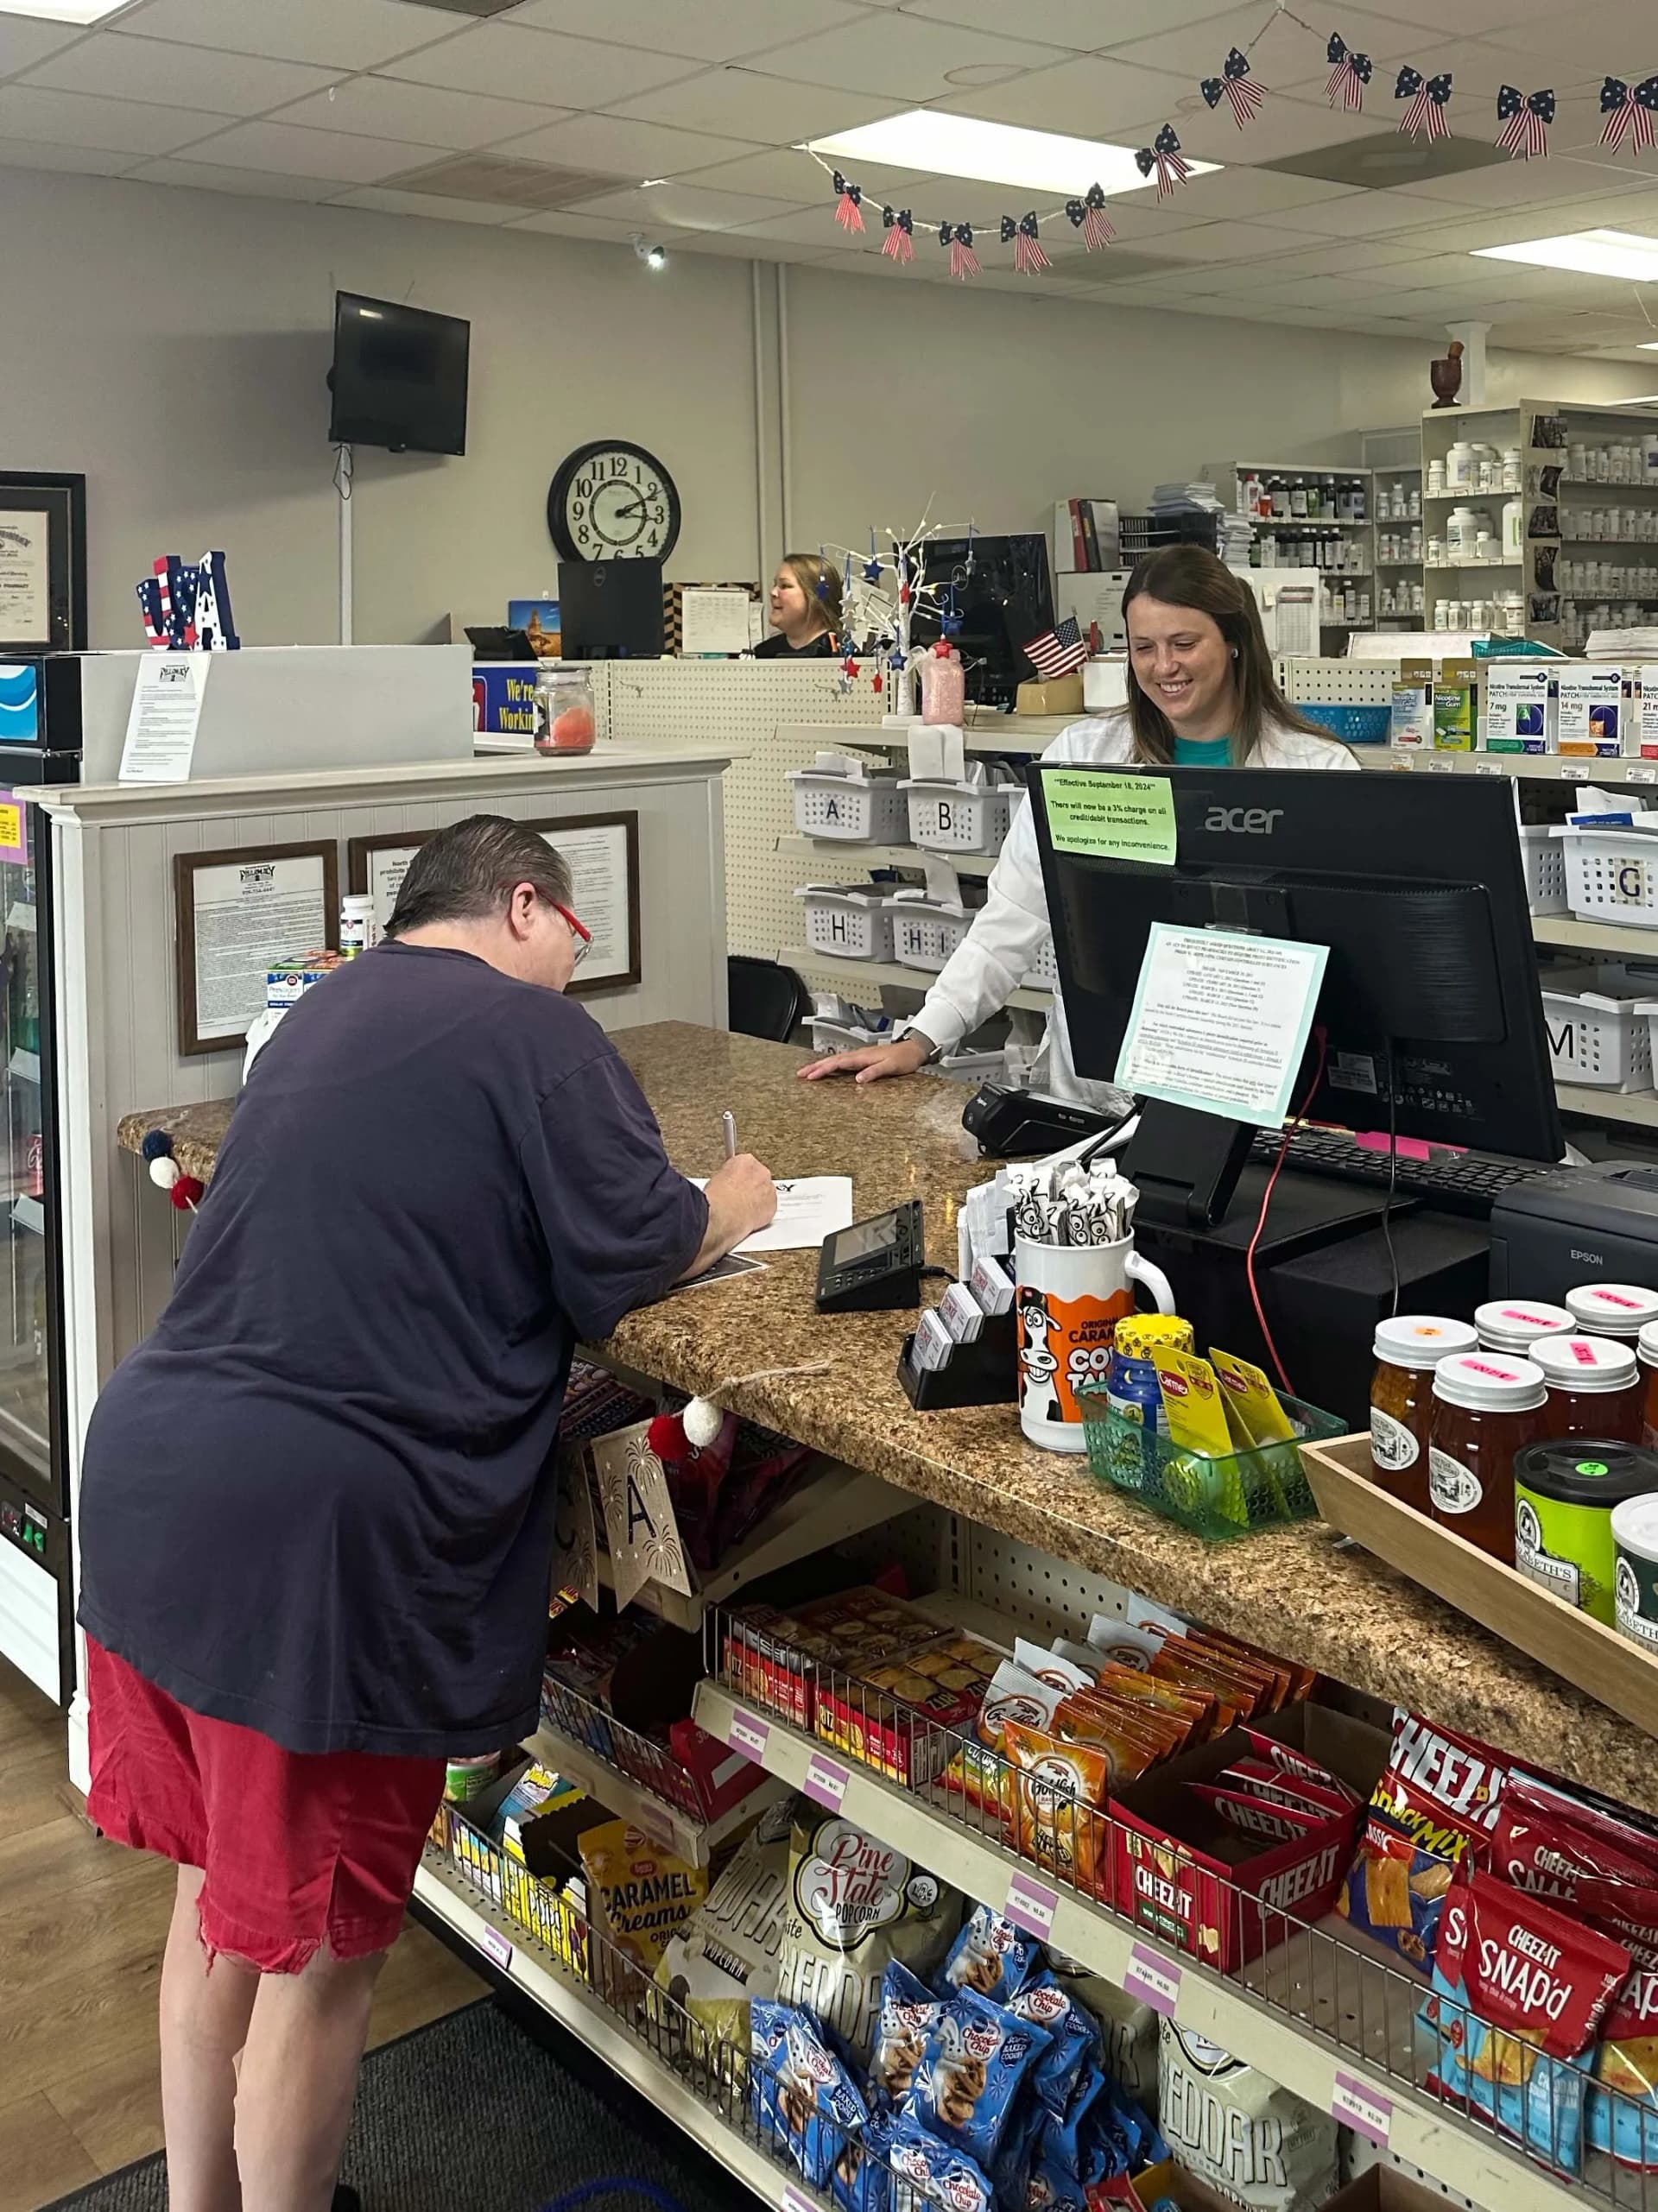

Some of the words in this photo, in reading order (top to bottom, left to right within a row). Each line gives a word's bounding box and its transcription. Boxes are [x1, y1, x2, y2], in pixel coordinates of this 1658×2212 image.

[590, 460, 605, 481] 11
[610, 457, 627, 477] 12
[636, 465, 641, 484] 1
[575, 478, 592, 498] 10
[648, 482, 657, 502] 2
[573, 501, 584, 521] 9
[655, 505, 664, 524] 3
[578, 524, 589, 544] 8
[647, 528, 658, 547] 4
[592, 544, 603, 560] 7
[506, 679, 535, 701] We're
[1568, 703, 1583, 711] mg
[499, 707, 534, 730] Workin
[1088, 781, 1123, 789] September
[826, 799, 839, 819] A
[939, 802, 952, 831] B
[1051, 800, 1068, 809] There
[1124, 806, 1147, 815] charge
[1070, 814, 1105, 823] credit/debit
[1107, 816, 1150, 825] transactions.
[1205, 806, 1284, 834] acer
[1067, 836, 1097, 845] apologize
[1108, 839, 1120, 849] any
[1122, 840, 1170, 850] inconvenience.
[1619, 868, 1641, 898] G
[832, 914, 845, 943] H
[909, 930, 921, 950] H
[1544, 1019, 1574, 1059] M
[1570, 1249, 1604, 1266] EPSON
[1069, 1330, 1115, 1343] CARAM
[628, 1475, 657, 1545] A
[831, 1833, 895, 1873] Pine
[600, 1872, 696, 1912] CARAMEL
[811, 1864, 886, 1912] State
[835, 1902, 880, 1924] POPCORN
[705, 1940, 747, 1978] POPCORN
[1033, 1998, 1053, 2013] Chip
[971, 2041, 990, 2055] Chip
